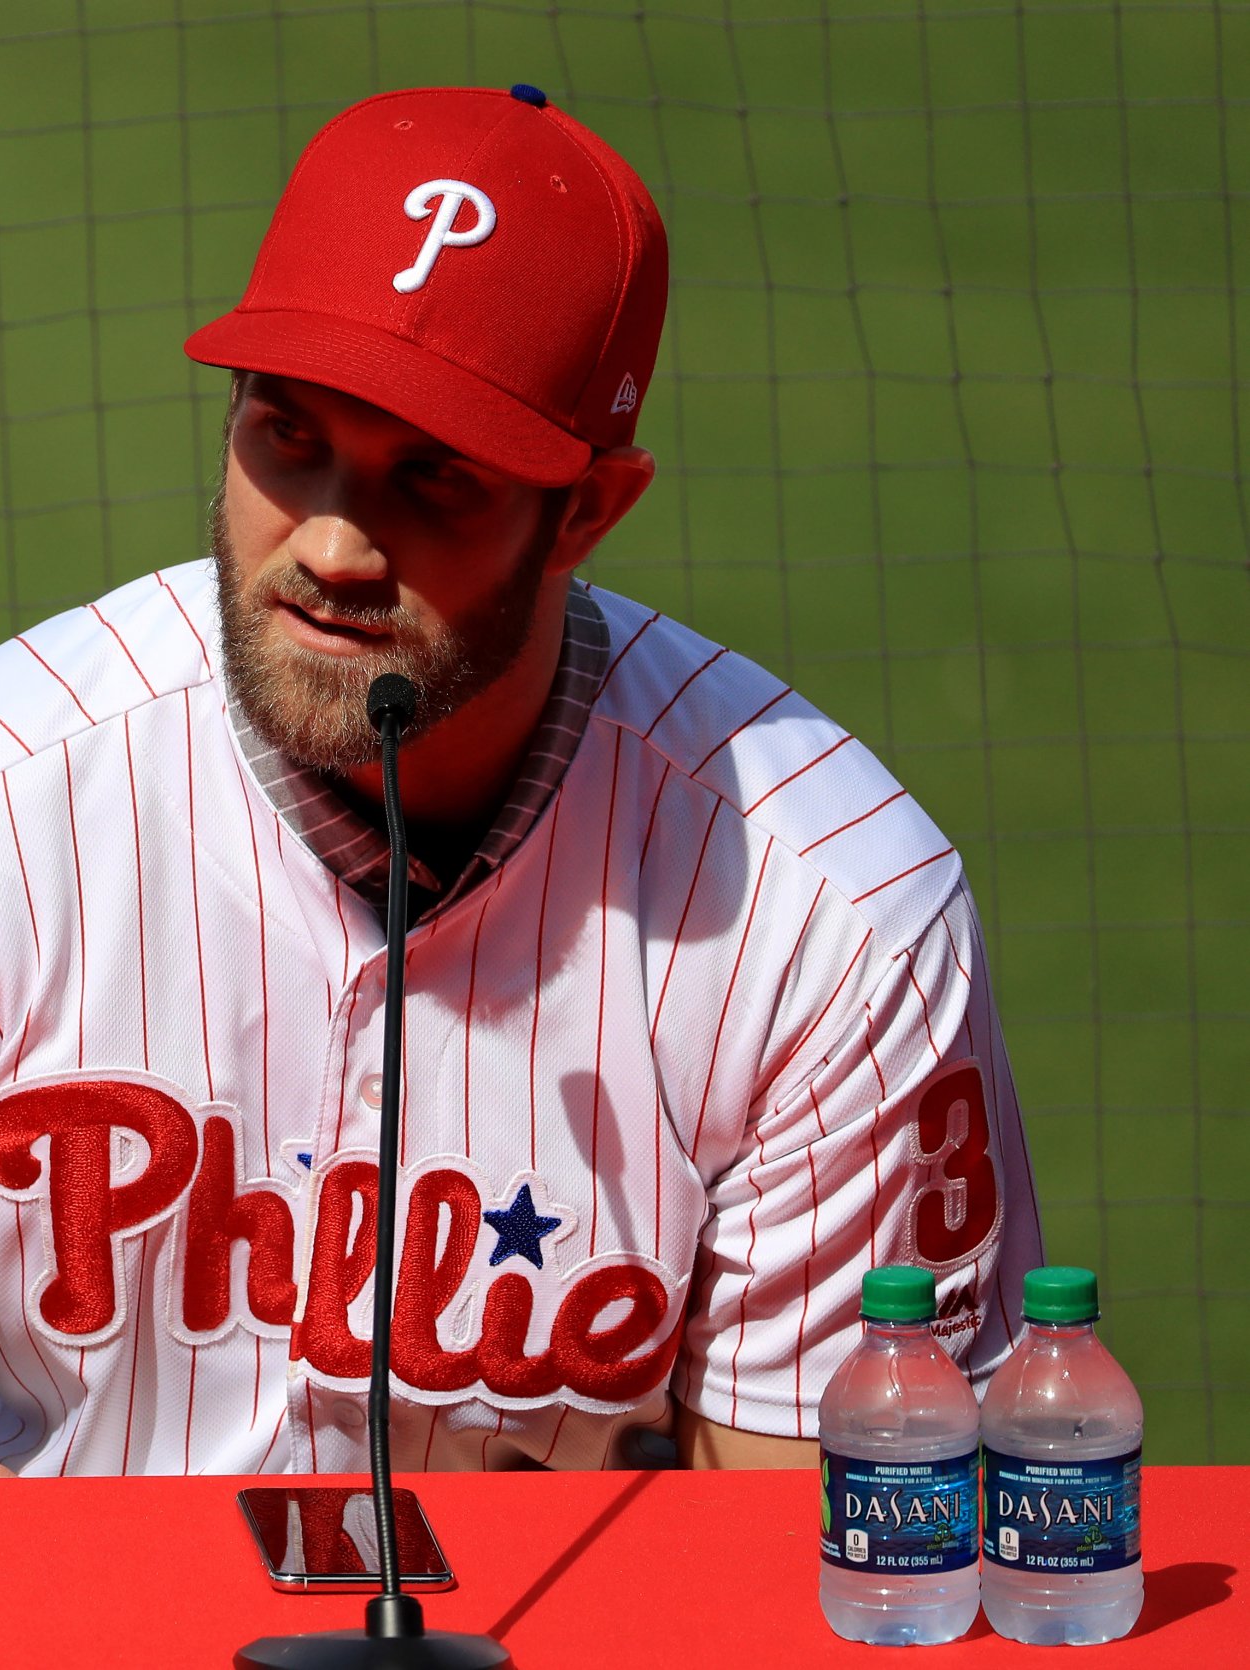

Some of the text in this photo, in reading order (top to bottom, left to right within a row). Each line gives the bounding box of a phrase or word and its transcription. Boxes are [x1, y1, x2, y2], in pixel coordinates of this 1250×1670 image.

[392, 179, 496, 293] P
[917, 1066, 997, 1263] 3
[875, 1466, 932, 1476] PURIFIED WATER
[1025, 1465, 1083, 1477] PURIFIED WATER
[846, 1490, 960, 1530] DASANI
[999, 1490, 1112, 1530] DASANI
[853, 1534, 859, 1546] 0
[1005, 1532, 1011, 1544] 0
[876, 1555, 886, 1566] 12
[887, 1556, 897, 1566] FL
[898, 1556, 909, 1566] OZ
[911, 1556, 929, 1567] (355
[1026, 1554, 1036, 1566] 12
[1036, 1556, 1047, 1566] FL
[1047, 1556, 1058, 1567] OZ
[1060, 1557, 1078, 1568] (355
